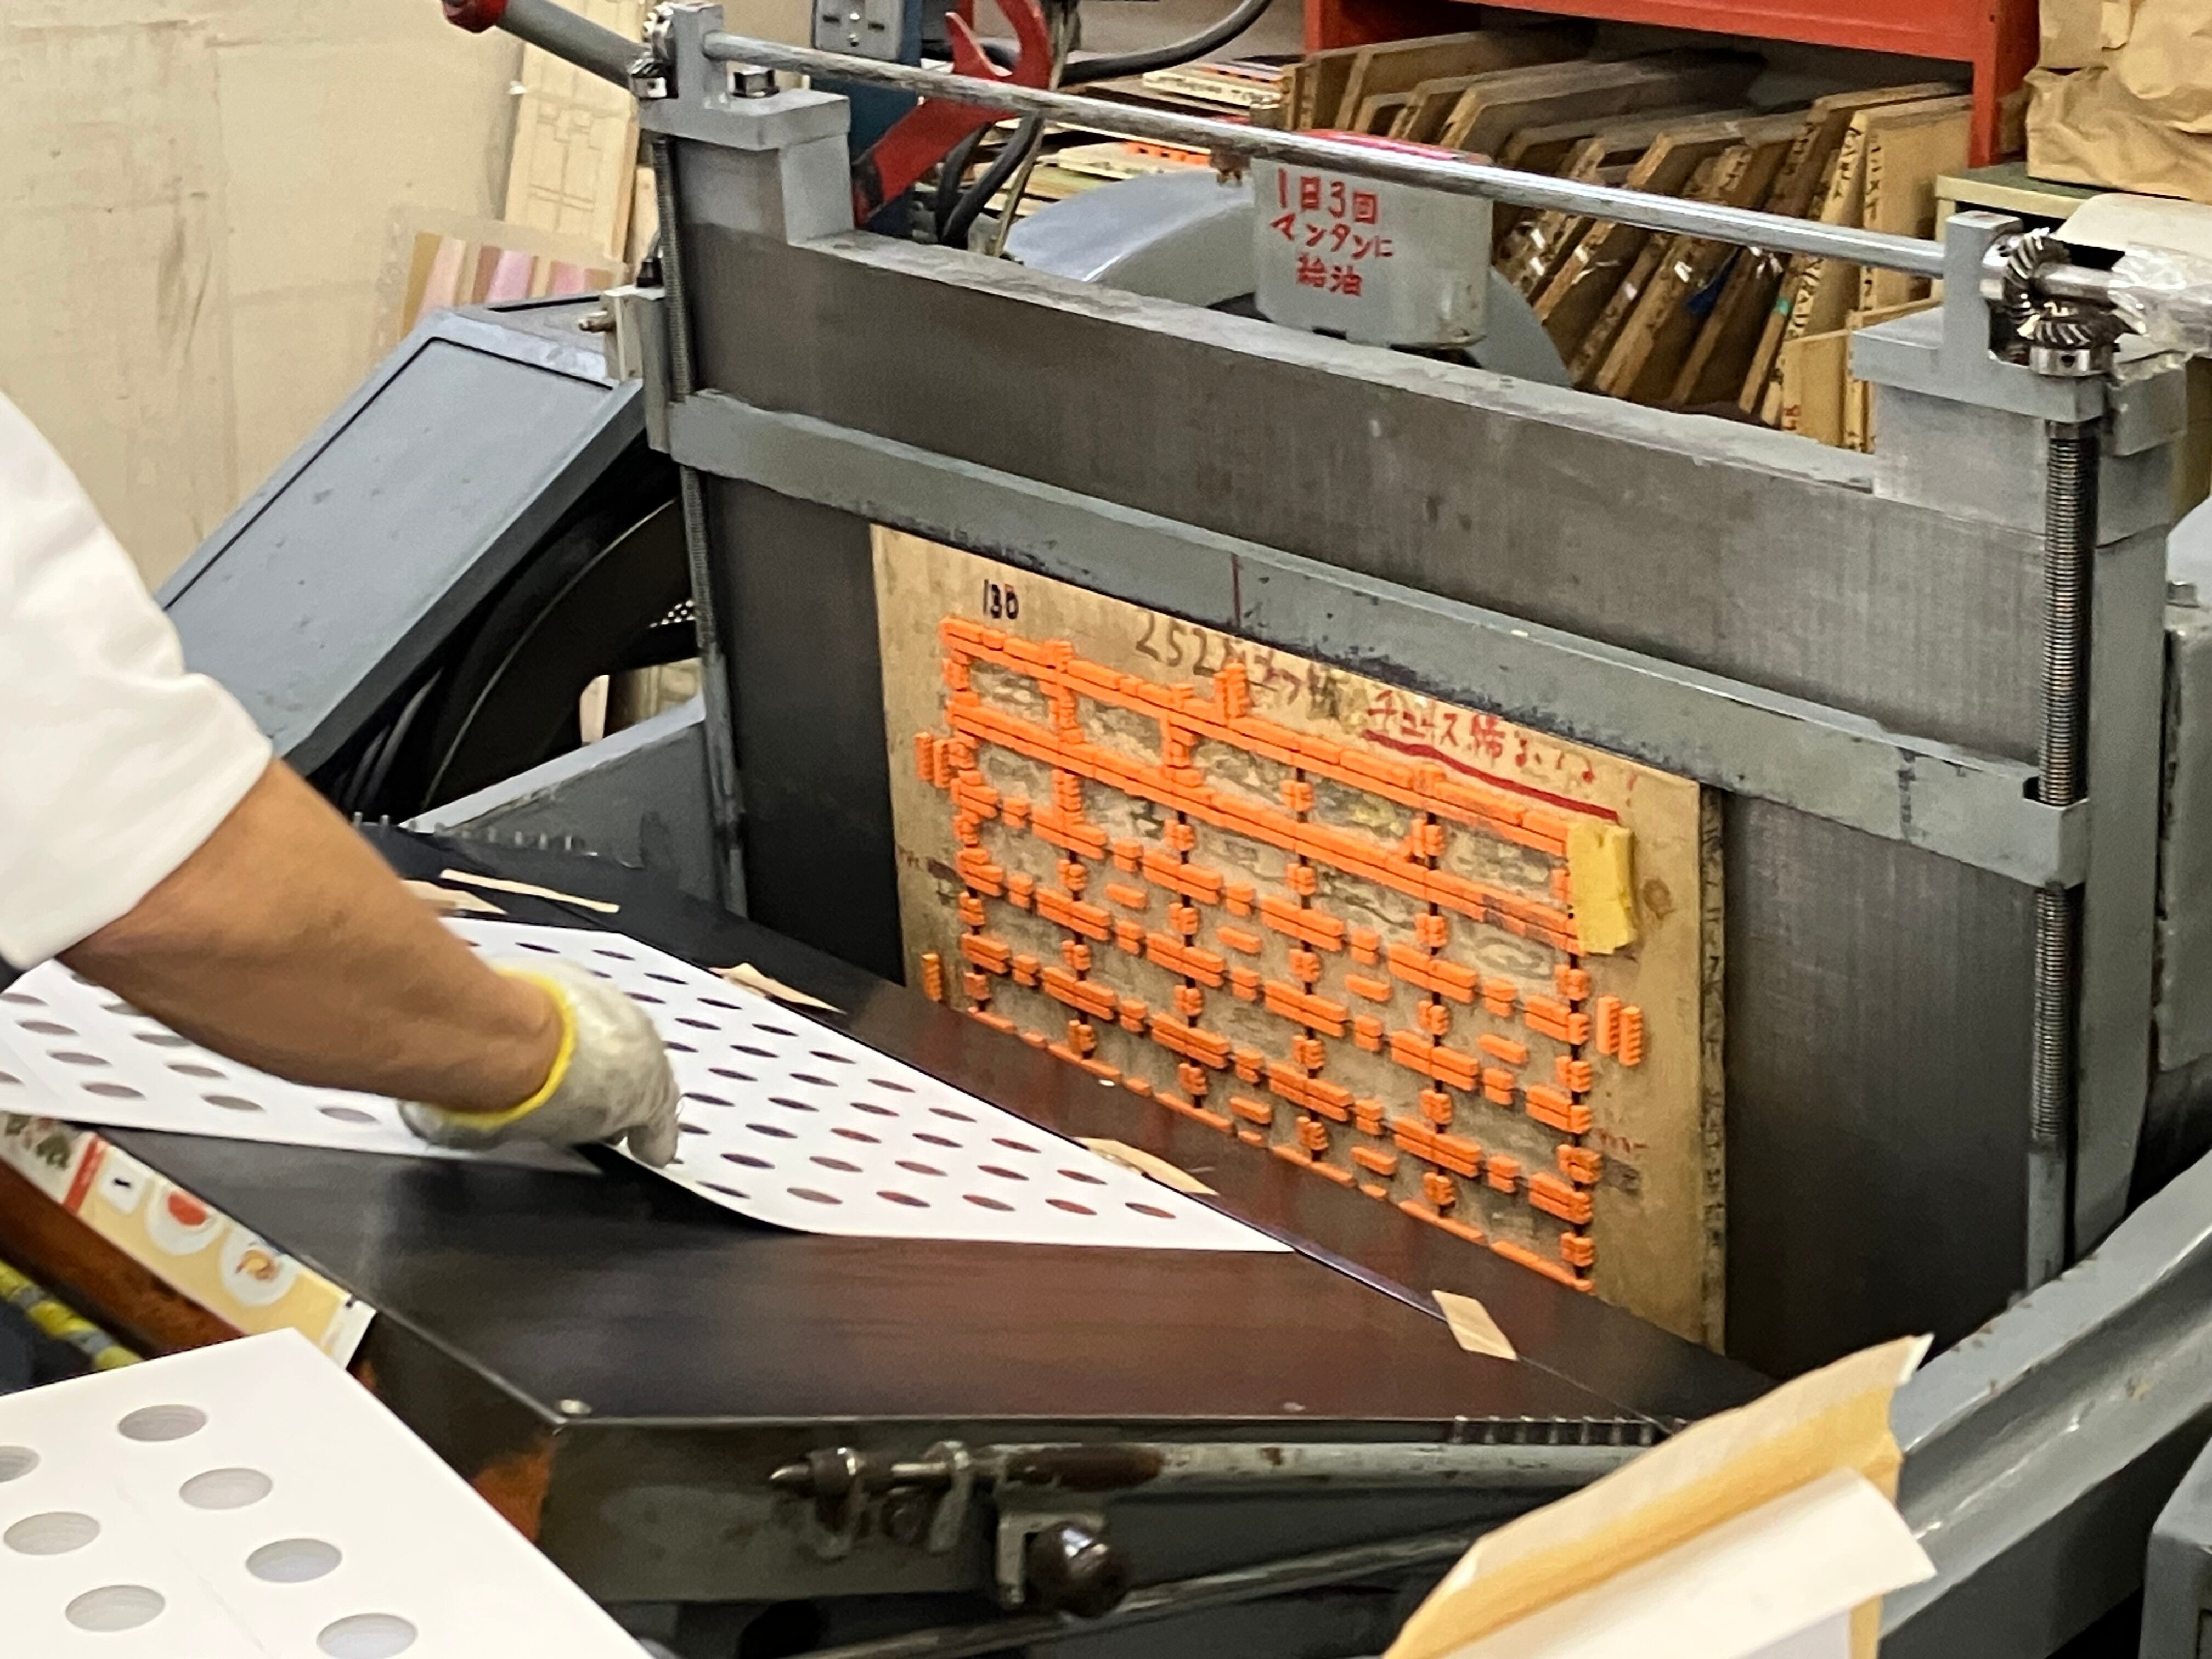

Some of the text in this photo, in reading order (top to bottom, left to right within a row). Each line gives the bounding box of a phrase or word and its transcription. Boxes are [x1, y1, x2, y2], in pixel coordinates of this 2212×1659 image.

[1278, 167, 1378, 225] 1日3回
[1268, 212, 1394, 261] マンタンに
[1296, 251, 1363, 291] 給油
